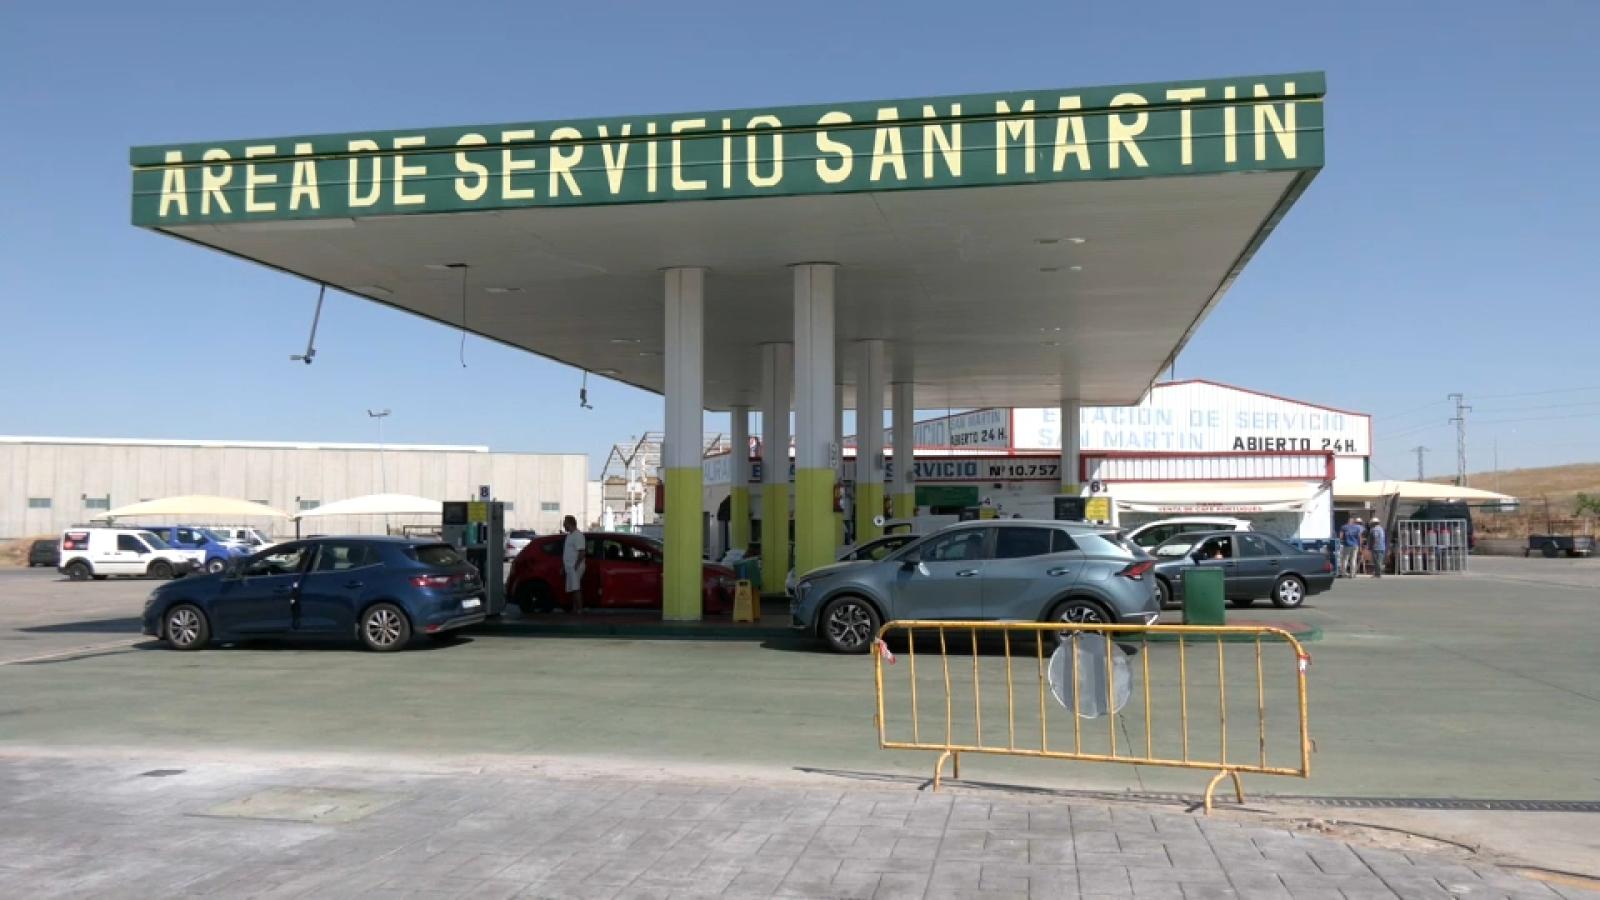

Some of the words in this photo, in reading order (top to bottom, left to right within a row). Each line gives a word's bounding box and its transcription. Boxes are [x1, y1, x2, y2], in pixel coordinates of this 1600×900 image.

[158, 142, 320, 217] AREA
[348, 136, 426, 208] DE
[454, 115, 783, 201] SERVICIO
[816, 103, 962, 184] SAN
[995, 82, 1296, 176] MARTIN
[1189, 409, 1220, 428] DE
[1235, 410, 1345, 431] SERVICIO
[981, 428, 995, 442] 24
[1103, 430, 1203, 449] MARTIN
[1232, 436, 1311, 451] ABIERTO
[1009, 464, 1058, 477] 10.757
